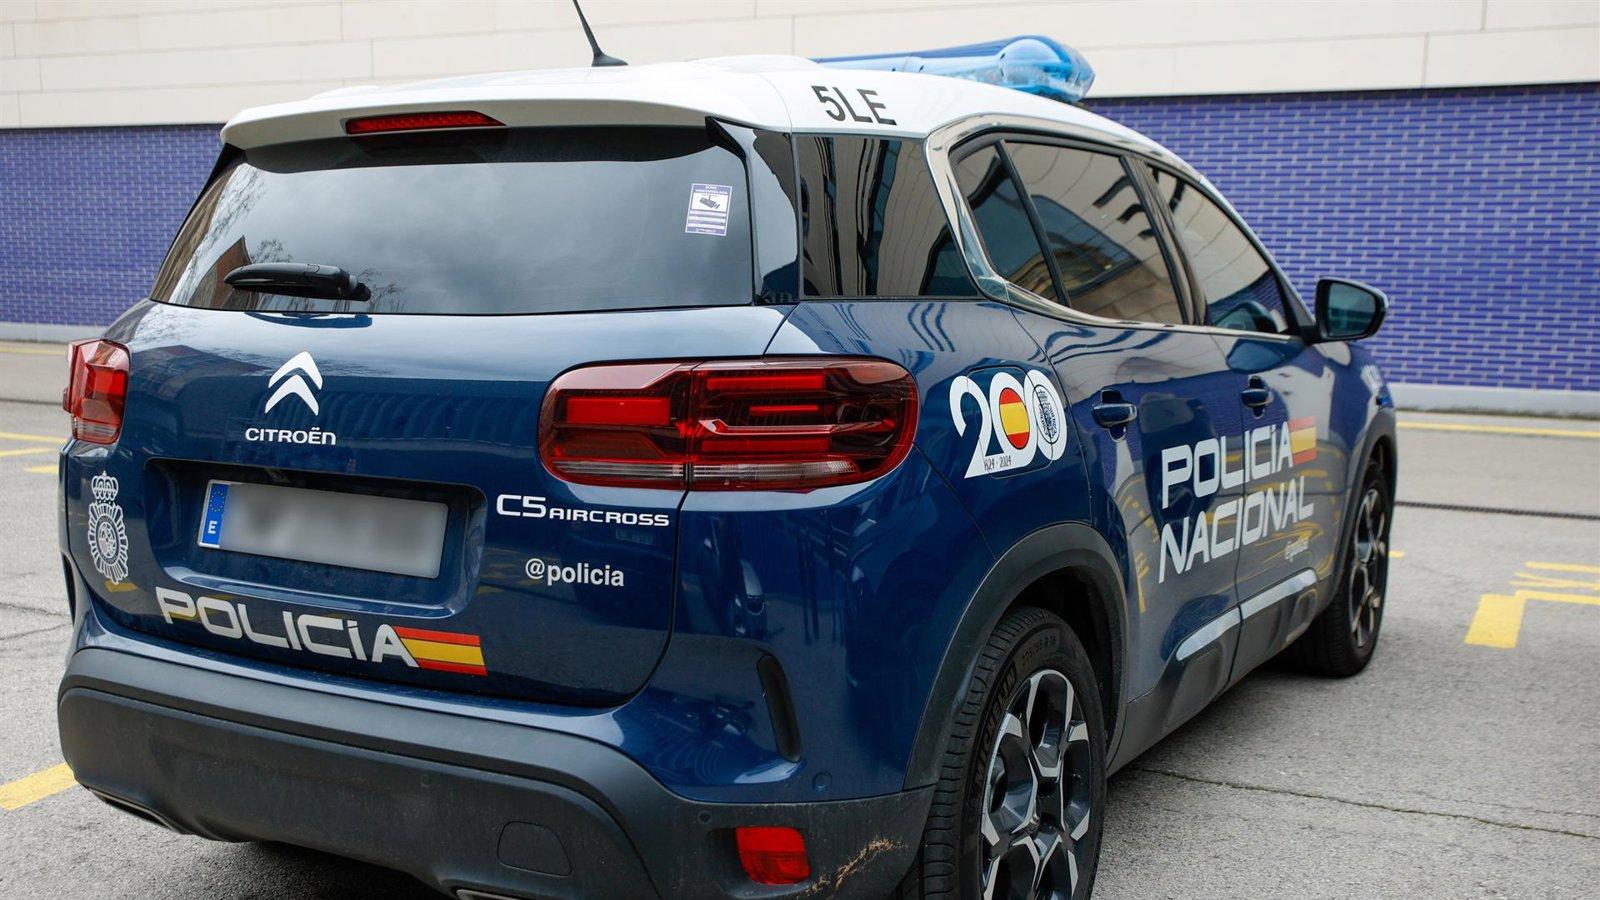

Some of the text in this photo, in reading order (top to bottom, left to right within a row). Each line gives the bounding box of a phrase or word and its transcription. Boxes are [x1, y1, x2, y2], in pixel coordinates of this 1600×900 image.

[811, 85, 898, 126] 5LE
[949, 369, 1068, 479] 200
[207, 520, 218, 535] E
[496, 494, 670, 527] C5 AIRCROSS
[1158, 475, 1315, 584] NACIONAL
[525, 557, 625, 587] @policia
